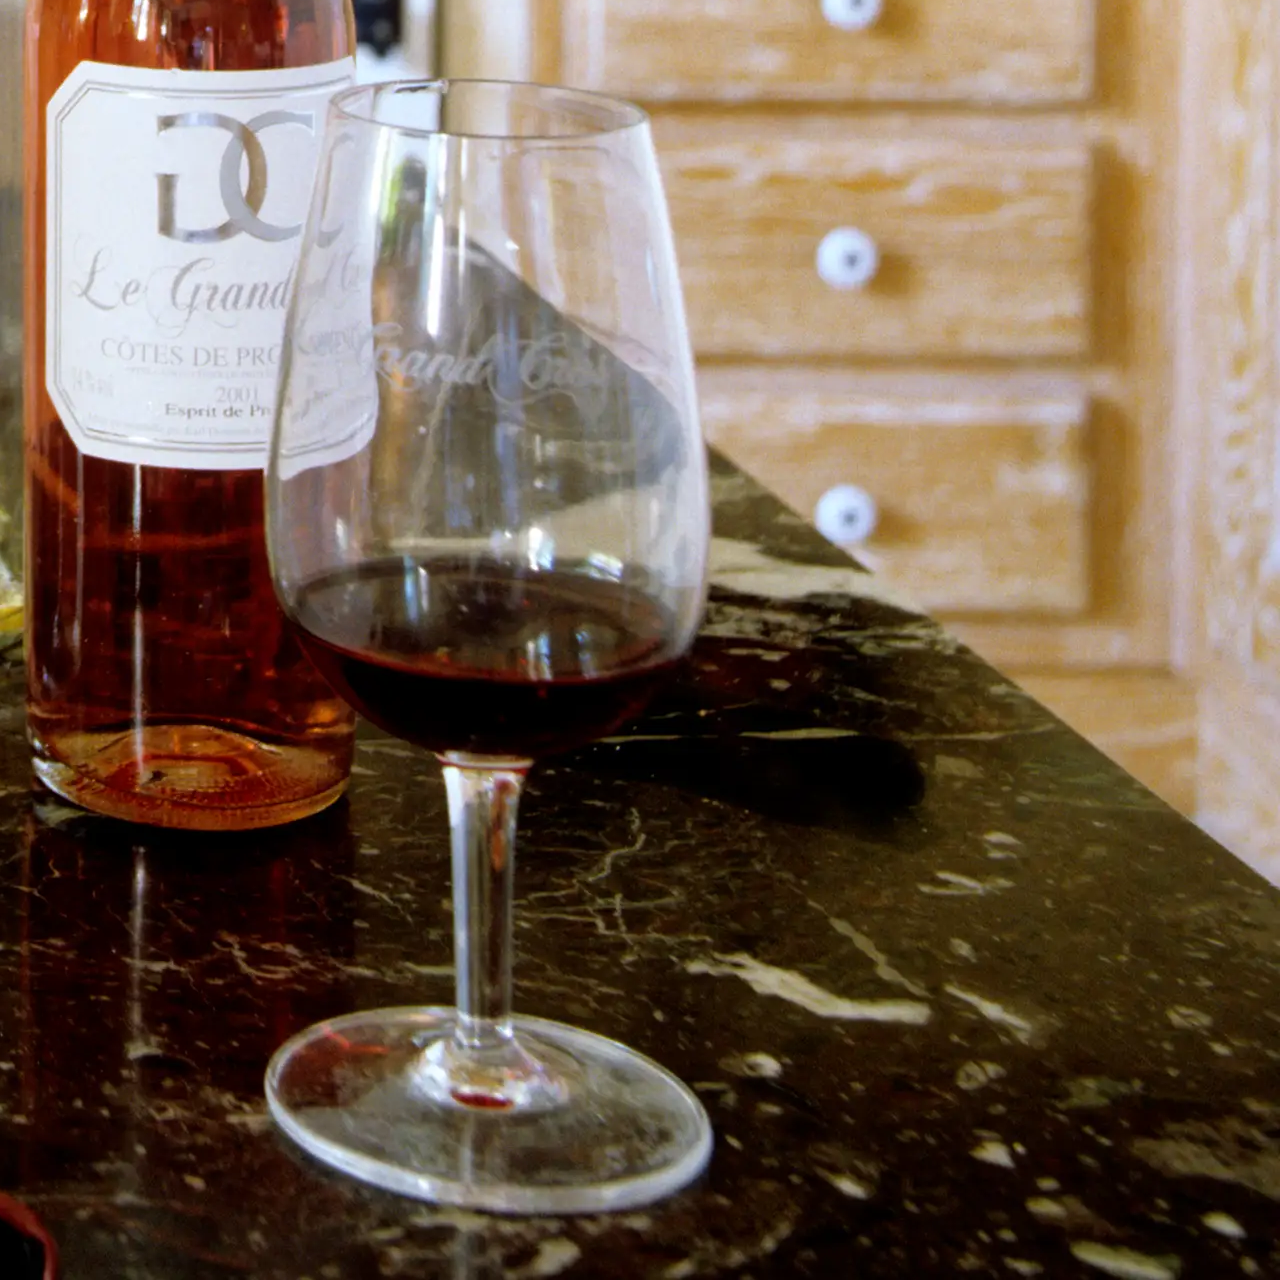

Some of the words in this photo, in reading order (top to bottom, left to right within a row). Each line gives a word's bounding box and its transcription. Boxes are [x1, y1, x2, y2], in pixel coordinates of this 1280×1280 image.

[69, 235, 144, 312] Le
[145, 257, 297, 339] Grand
[100, 335, 184, 366] CÔTES
[192, 347, 229, 368] DE
[216, 385, 259, 404] 2001
[164, 402, 217, 420] Esprit
[222, 403, 243, 418] de
